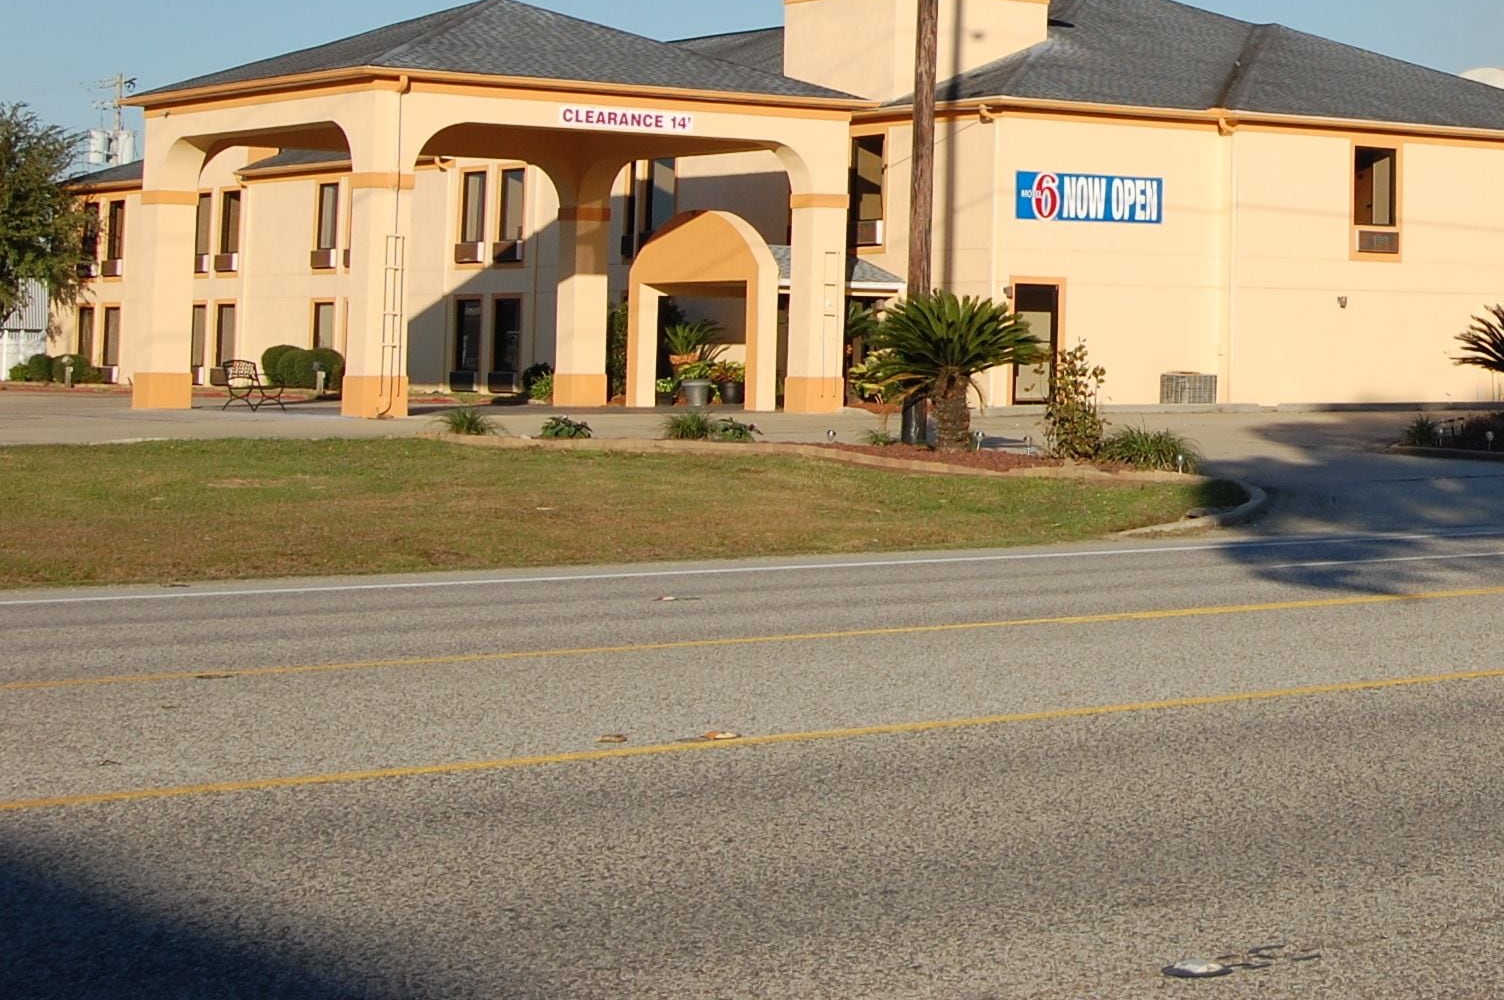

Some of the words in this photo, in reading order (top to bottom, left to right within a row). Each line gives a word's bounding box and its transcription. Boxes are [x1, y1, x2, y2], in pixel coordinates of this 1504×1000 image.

[562, 108, 664, 128] CLEARANCE
[670, 115, 691, 129] 14'
[1034, 174, 1057, 219] 6
[1062, 176, 1106, 219] NOW
[1111, 177, 1158, 221] OPEN
